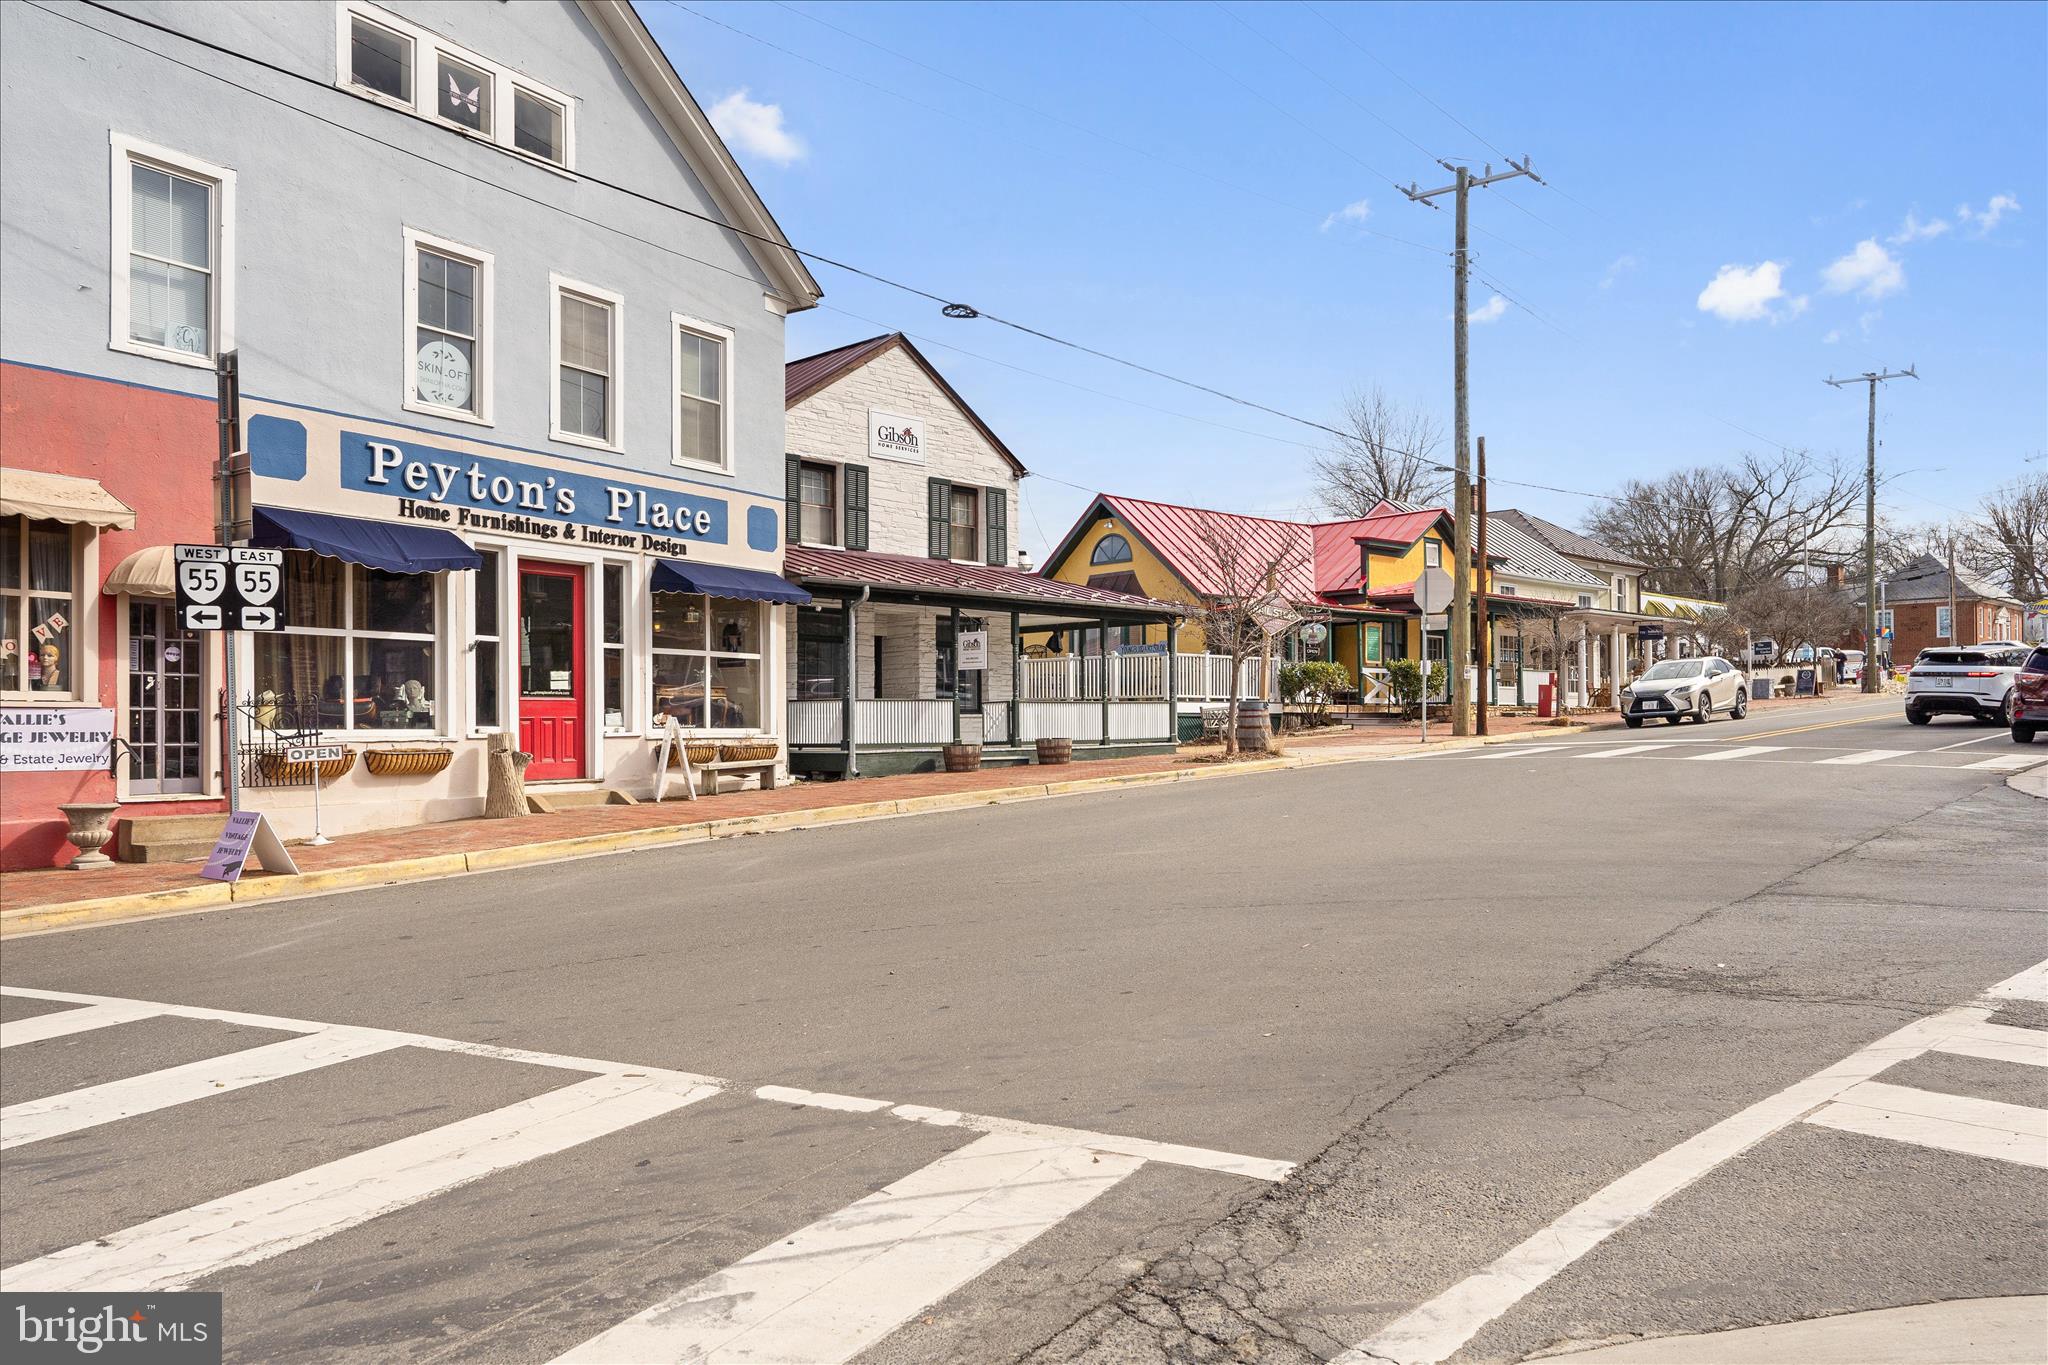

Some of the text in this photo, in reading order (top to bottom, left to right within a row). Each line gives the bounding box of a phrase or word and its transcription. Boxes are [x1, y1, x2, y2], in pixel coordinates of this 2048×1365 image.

[878, 425, 918, 446] Gibson
[895, 445, 919, 454] SERVICES
[366, 441, 710, 534] Peyton's Place
[398, 498, 687, 556] Home Furnishings & Interior Design
[184, 548, 221, 559] WEST
[240, 551, 274, 562] EAST
[189, 568, 218, 592] 55
[244, 570, 272, 593] 55
[29, 731, 112, 743] JEWELRY
[13, 754, 55, 765] Estate
[58, 753, 110, 766] Jewelry
[290, 748, 340, 760] OPEN
[225, 831, 249, 841] VINTAGE
[217, 847, 243, 857] JEWELRY
